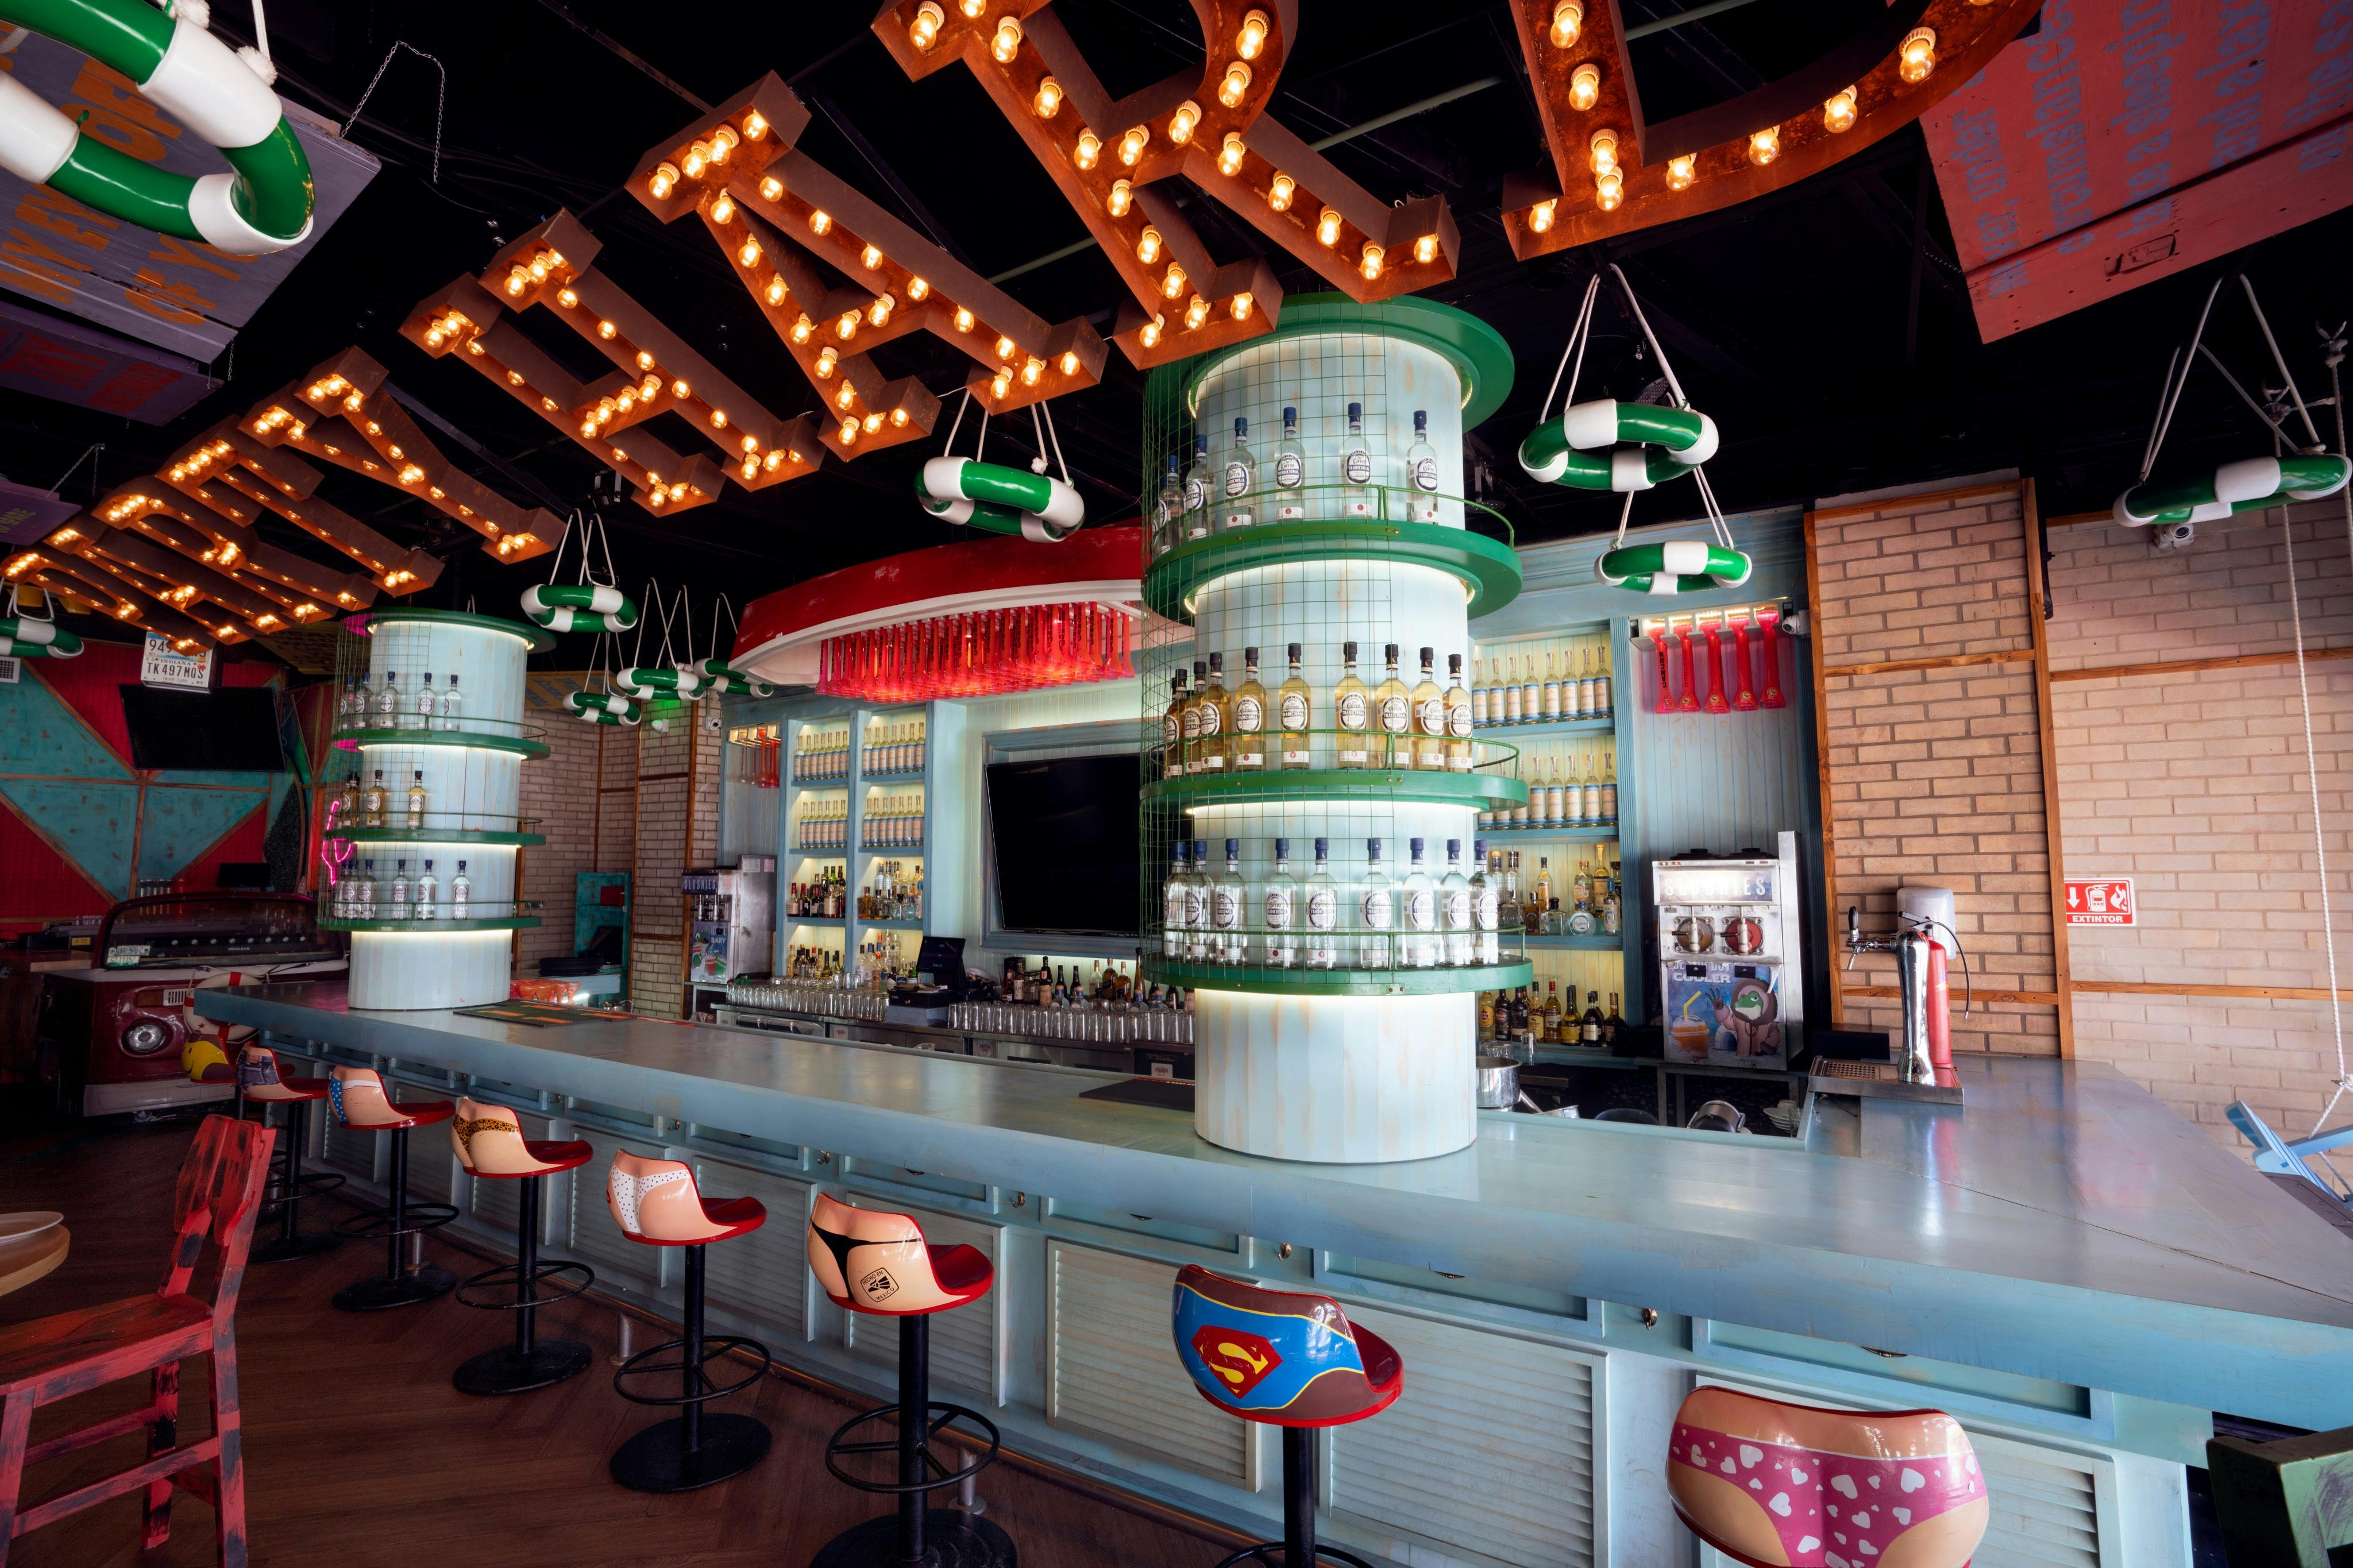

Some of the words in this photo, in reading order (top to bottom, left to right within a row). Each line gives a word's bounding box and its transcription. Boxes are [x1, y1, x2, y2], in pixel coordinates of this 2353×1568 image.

[2199, 92, 2261, 165] and
[2126, 130, 2172, 164] a
[1950, 109, 2008, 200] under
[684, 879, 716, 890] SLUSHIES
[1673, 972, 1731, 983] COOLER
[862, 1275, 876, 1285] HECHO
[876, 1287, 894, 1300] MEXICO
